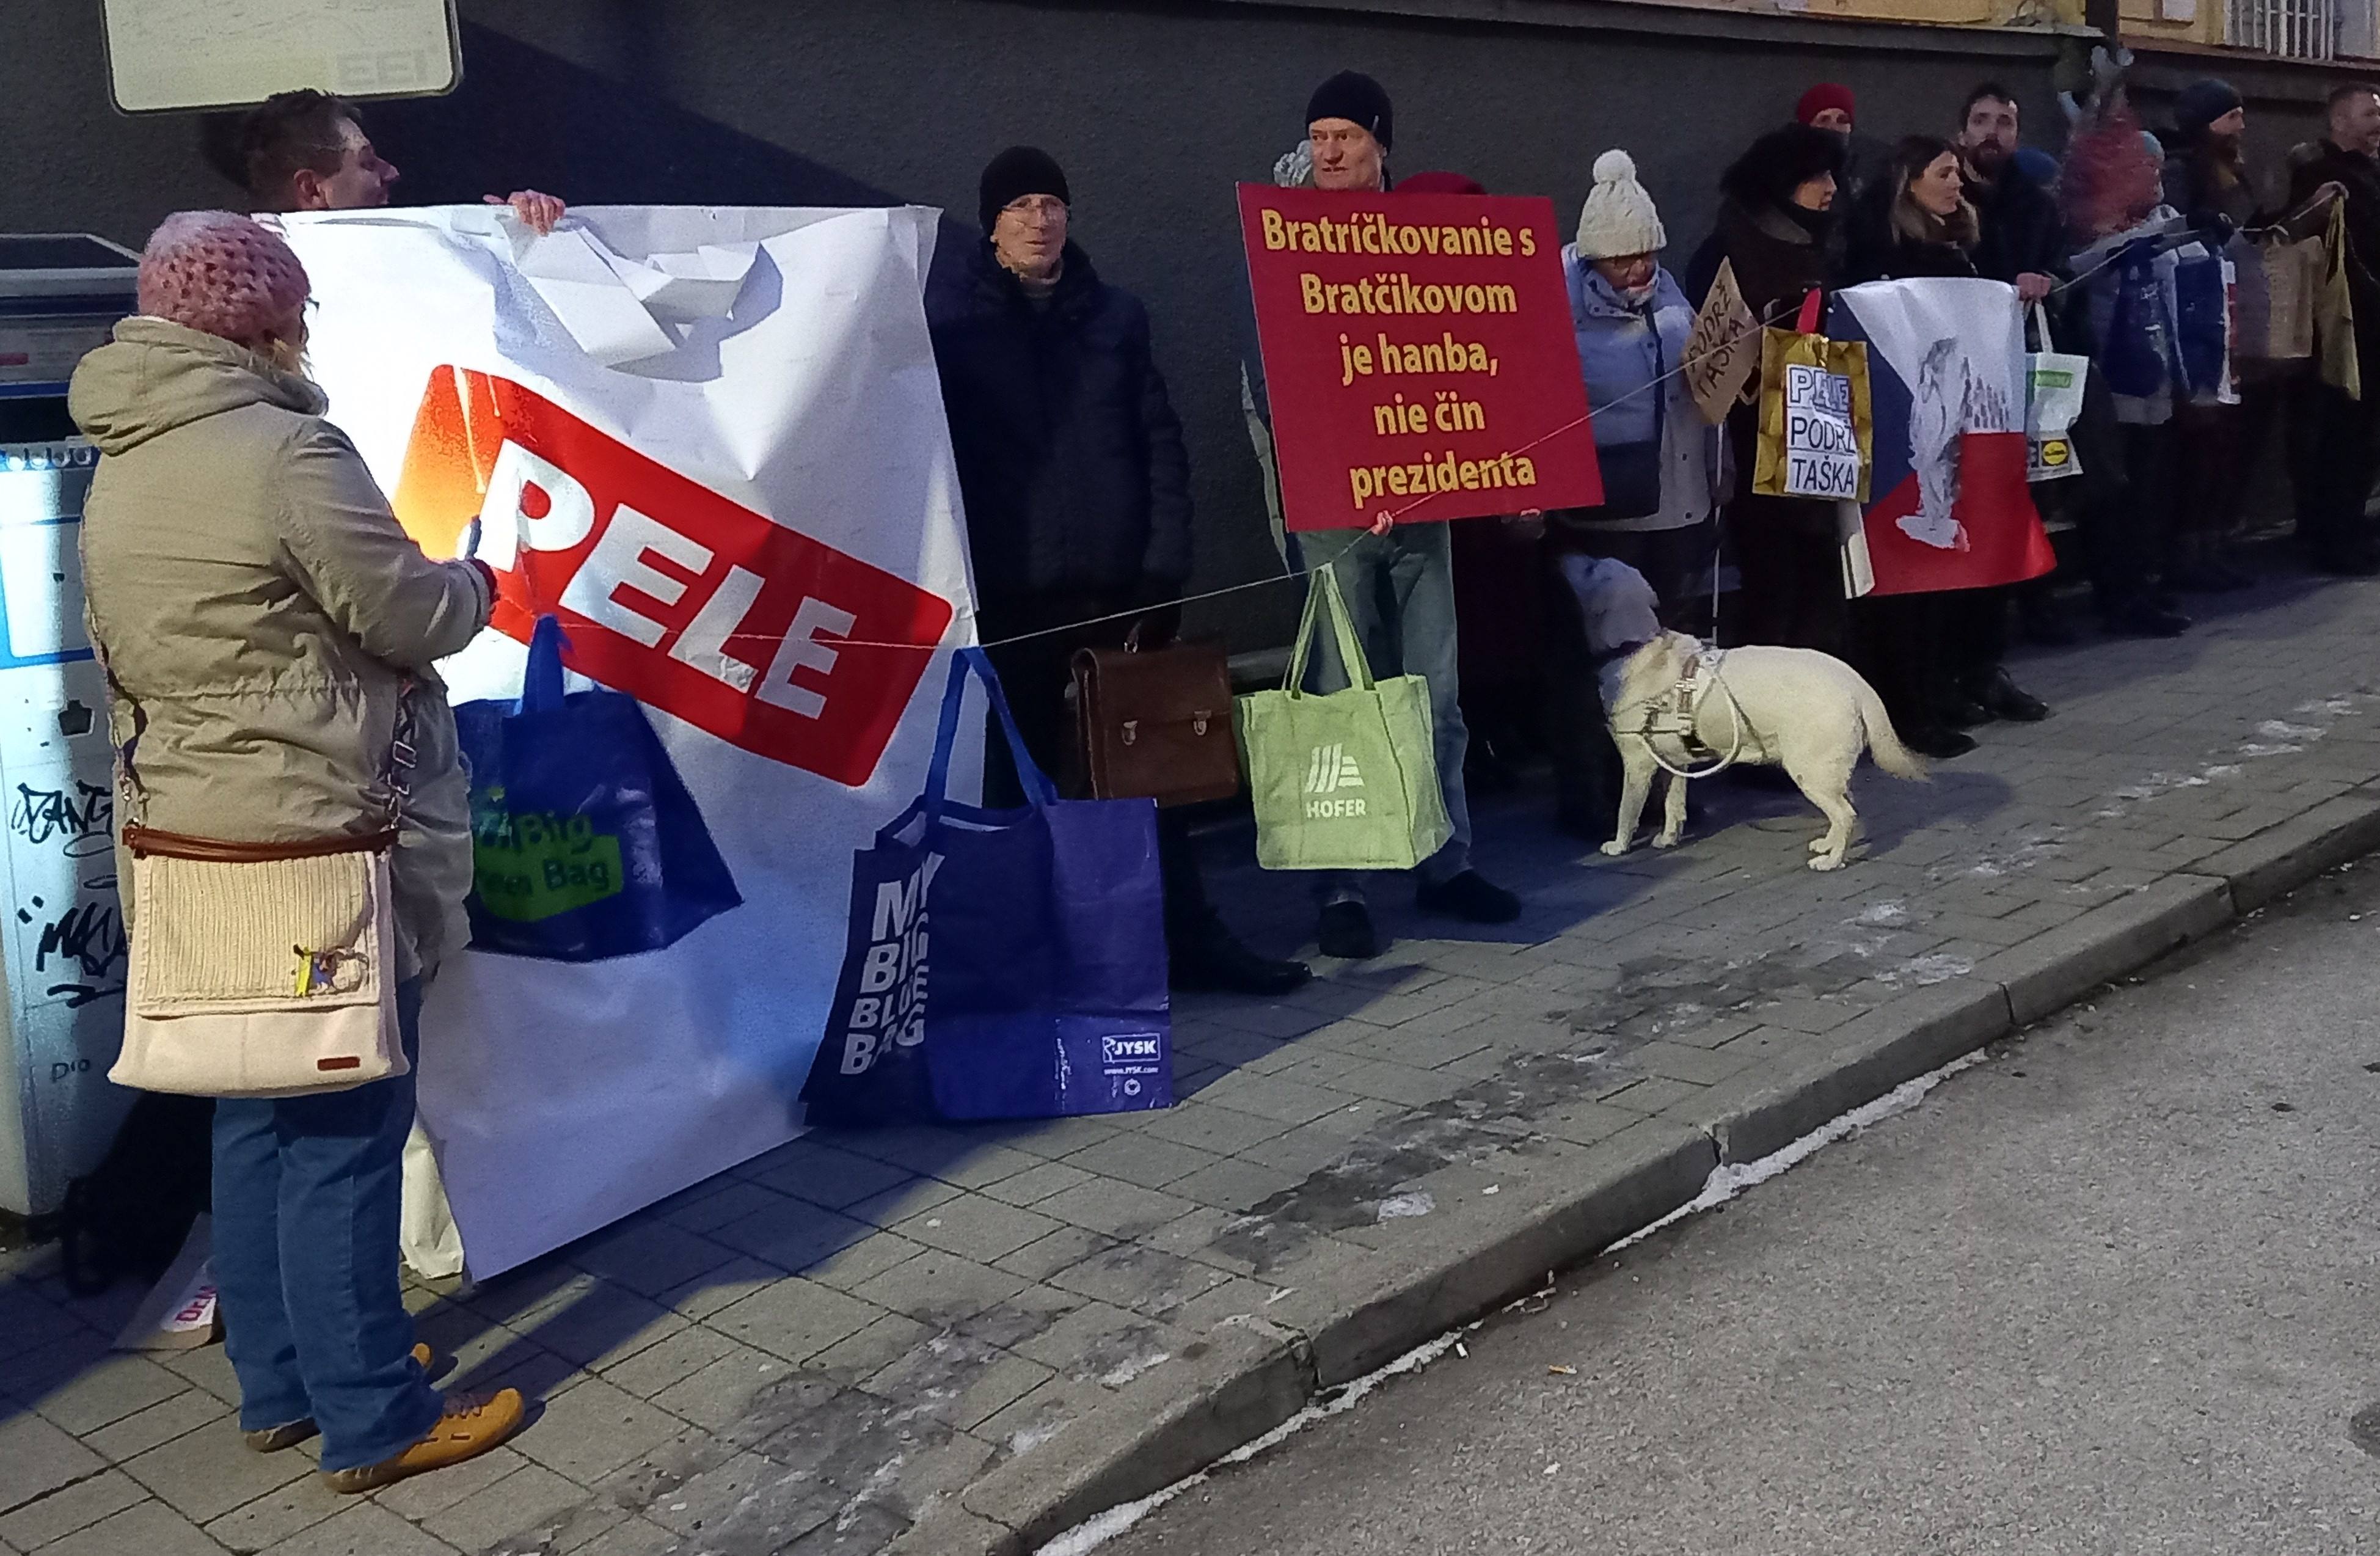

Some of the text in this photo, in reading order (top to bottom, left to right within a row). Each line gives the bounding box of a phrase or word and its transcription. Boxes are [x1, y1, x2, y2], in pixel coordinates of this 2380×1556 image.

[1261, 208, 1536, 256] Bratríčkovanie s
[1300, 273, 1517, 314] Bratčikovom
[1340, 332, 1498, 386] je hanba,
[1374, 392, 1485, 435] nie čin
[1349, 451, 1537, 509] prezidenta
[1792, 455, 1855, 493] TAŠKA
[481, 438, 857, 720] PELE
[1306, 798, 1366, 818] HOFER
[543, 858, 610, 893] Bag
[872, 851, 945, 941] MY
[860, 912, 929, 993] BIG
[849, 965, 929, 1029] BLUE
[840, 1004, 926, 1075] BAG
[1114, 1040, 1157, 1055] JYSK
